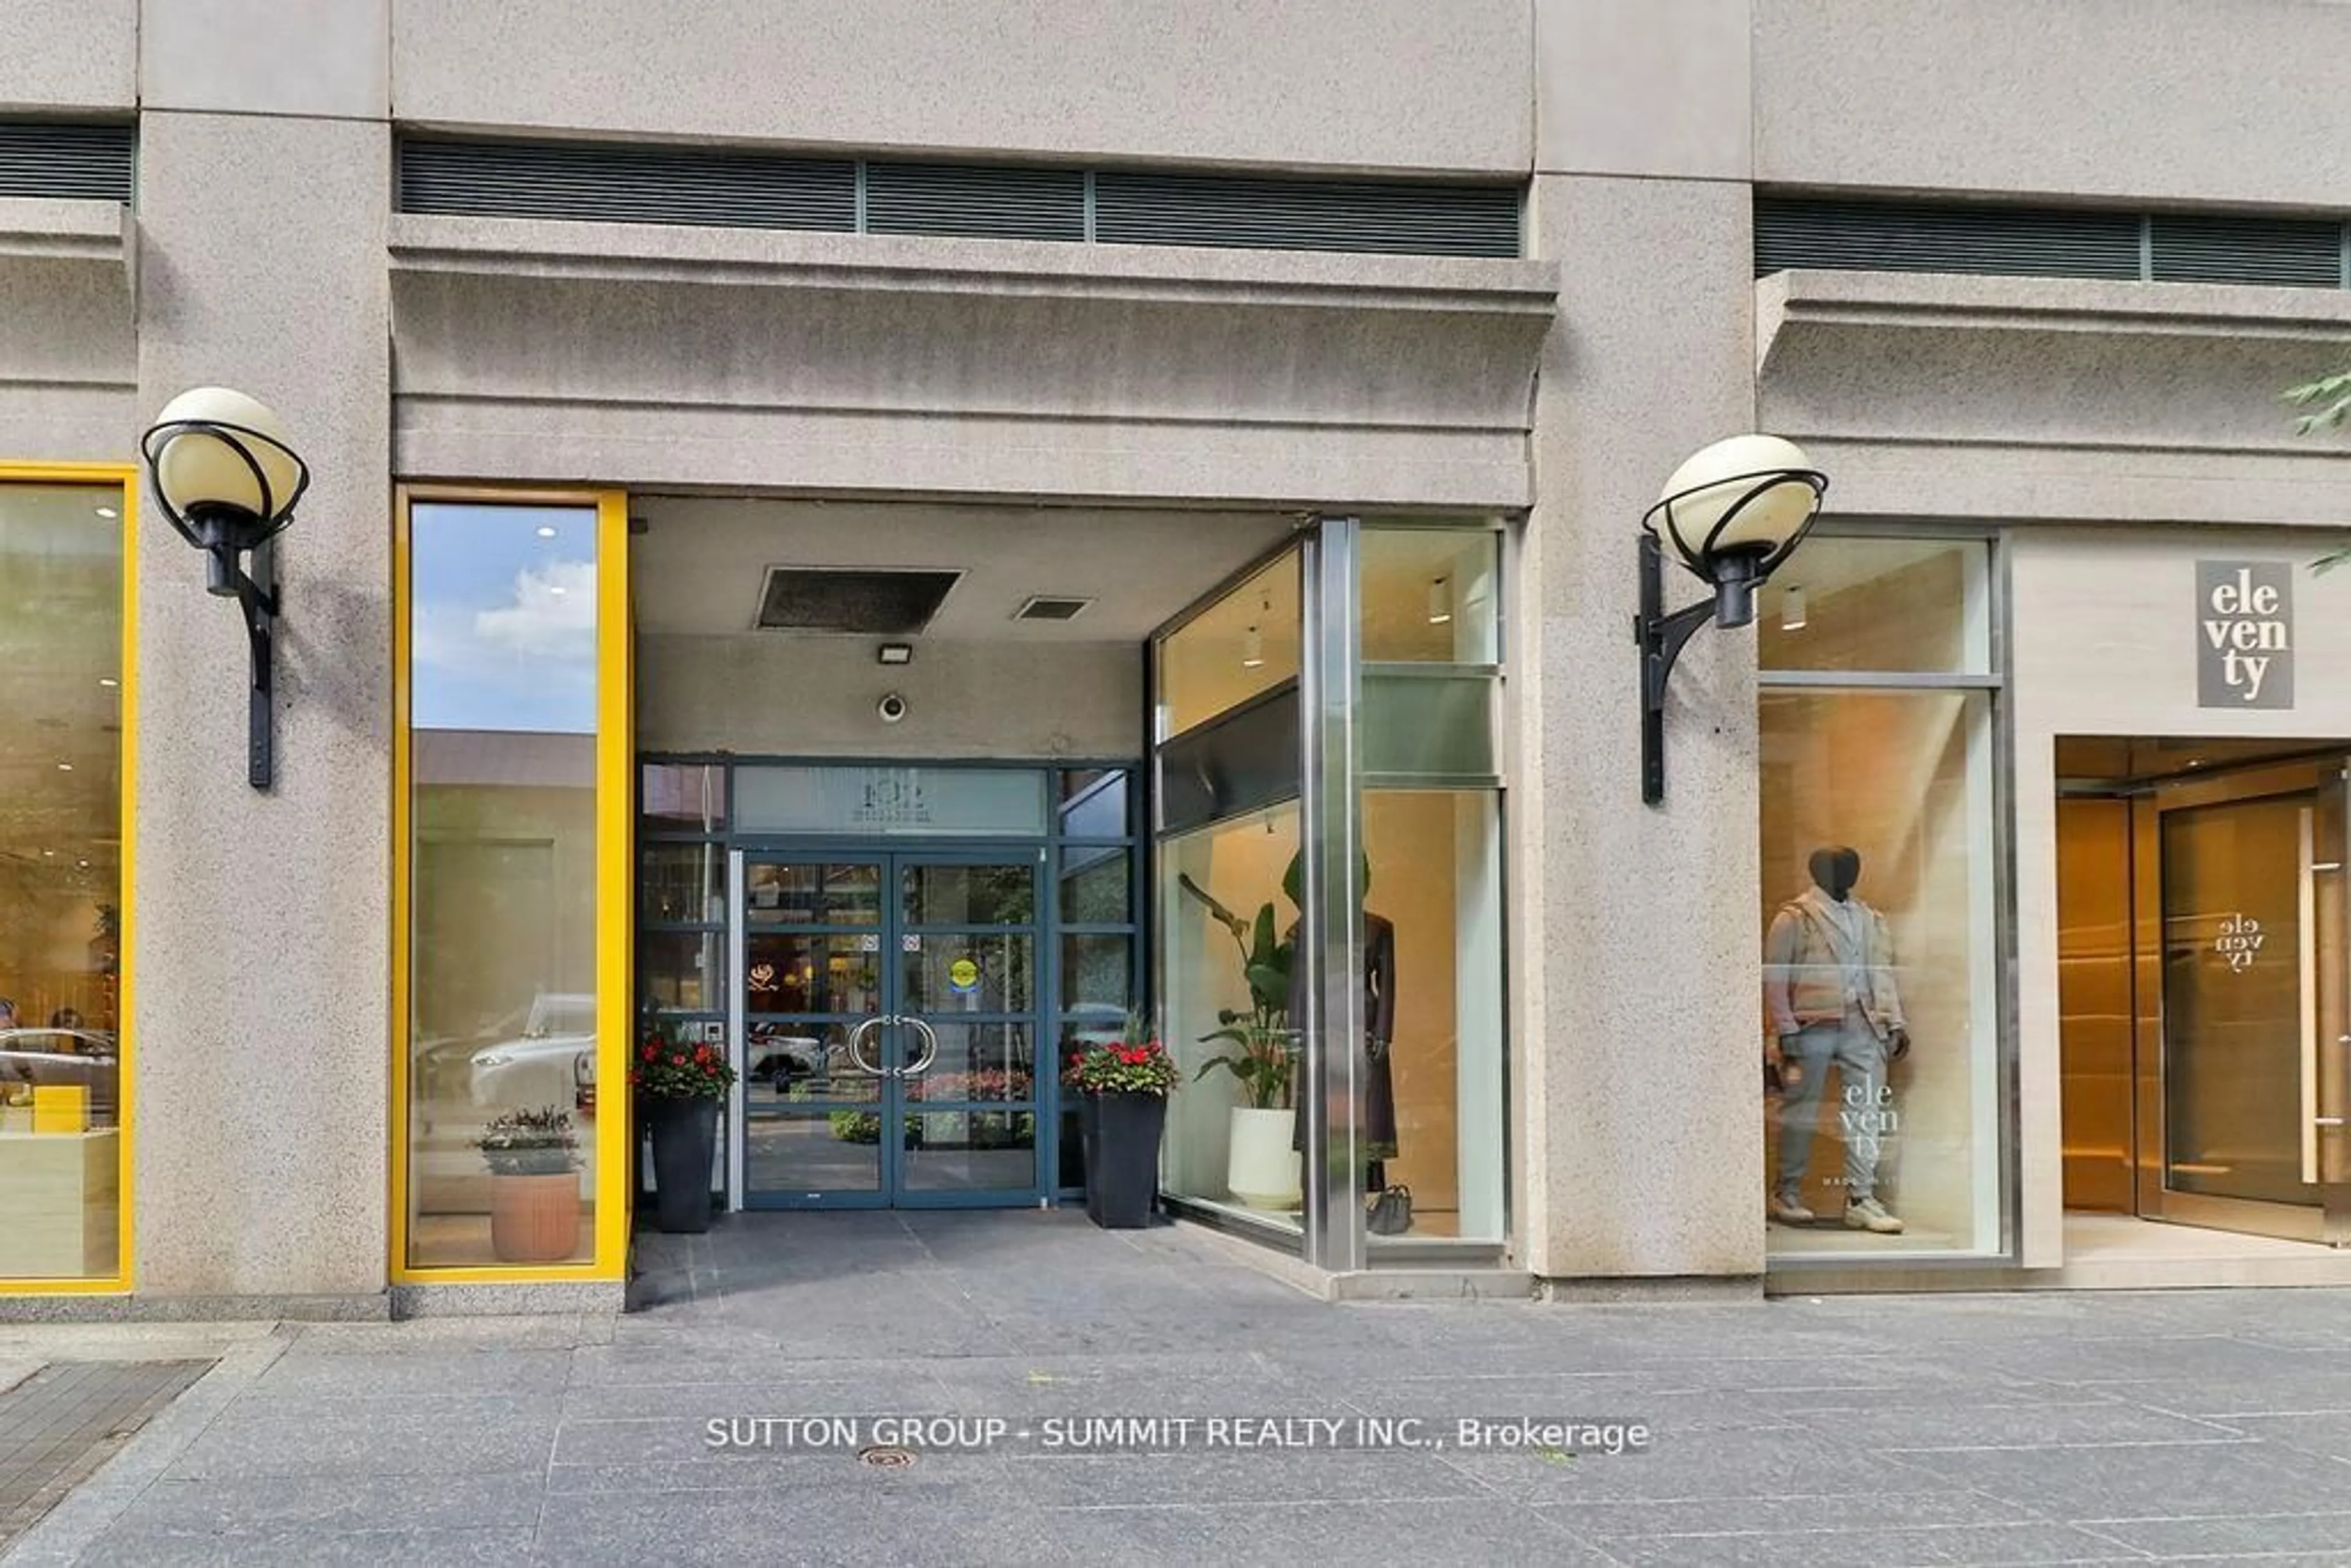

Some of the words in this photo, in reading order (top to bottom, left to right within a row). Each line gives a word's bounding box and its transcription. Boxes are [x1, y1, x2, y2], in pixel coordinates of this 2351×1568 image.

[2211, 568, 2279, 614] ele
[2203, 619, 2288, 650] ven
[2222, 649, 2270, 700] ty
[1846, 1071, 1893, 1106] ele
[1839, 1110, 1899, 1131] ven
